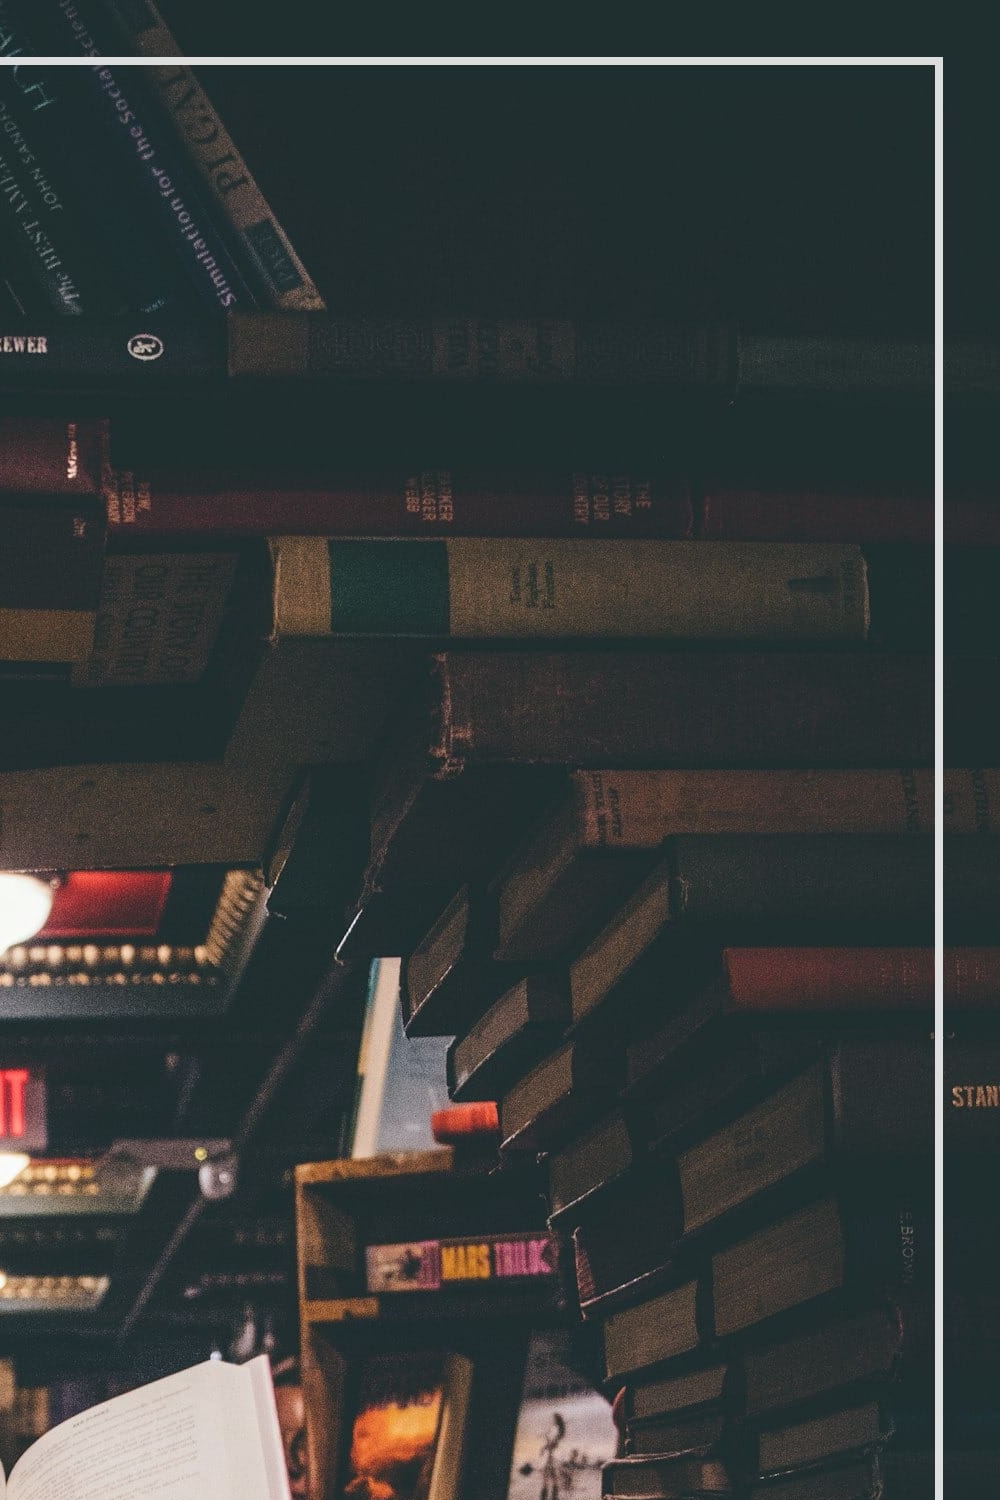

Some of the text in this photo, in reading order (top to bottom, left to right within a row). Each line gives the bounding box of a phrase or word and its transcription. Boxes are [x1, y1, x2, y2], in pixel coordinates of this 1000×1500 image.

[126, 123, 156, 161] the
[28, 164, 64, 214] JOHN
[148, 163, 177, 199] for
[21, 215, 62, 272] BEST
[165, 194, 238, 309] Simulation
[593, 494, 608, 520] OUR
[951, 1085, 999, 1108] STAN
